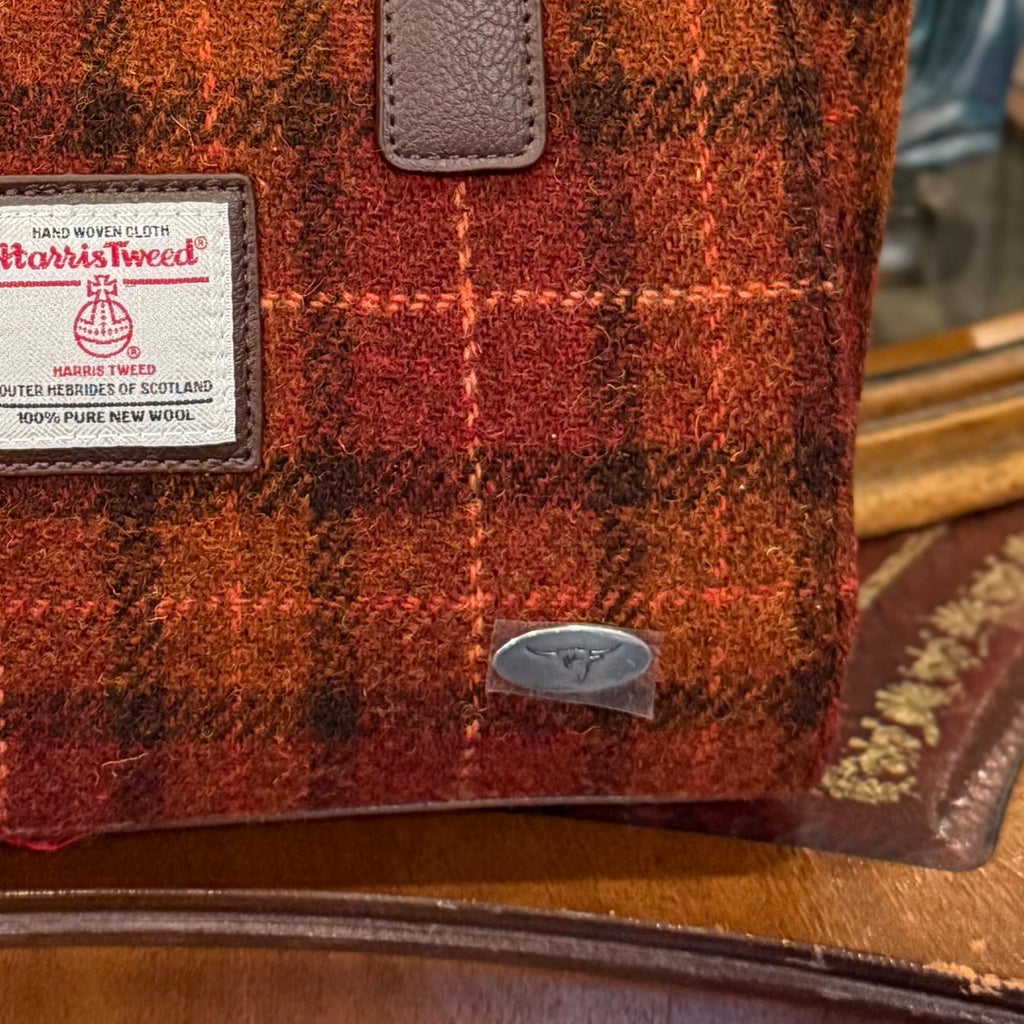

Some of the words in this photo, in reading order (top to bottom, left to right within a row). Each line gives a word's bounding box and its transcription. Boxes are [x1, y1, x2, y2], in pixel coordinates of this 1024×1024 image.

[33, 227, 71, 239] HAND
[74, 226, 122, 238] WOVEN
[126, 225, 170, 238] CLOTH
[53, 365, 104, 377] HARRIS
[108, 364, 156, 376] TWEED
[47, 384, 114, 397] HEBRIDES
[119, 384, 136, 395] OF
[141, 381, 212, 394] SCOTLAND
[17, 411, 60, 424] 100%
[64, 411, 106, 424] PURE
[110, 410, 144, 423] NEW
[149, 409, 195, 422] WOOL
